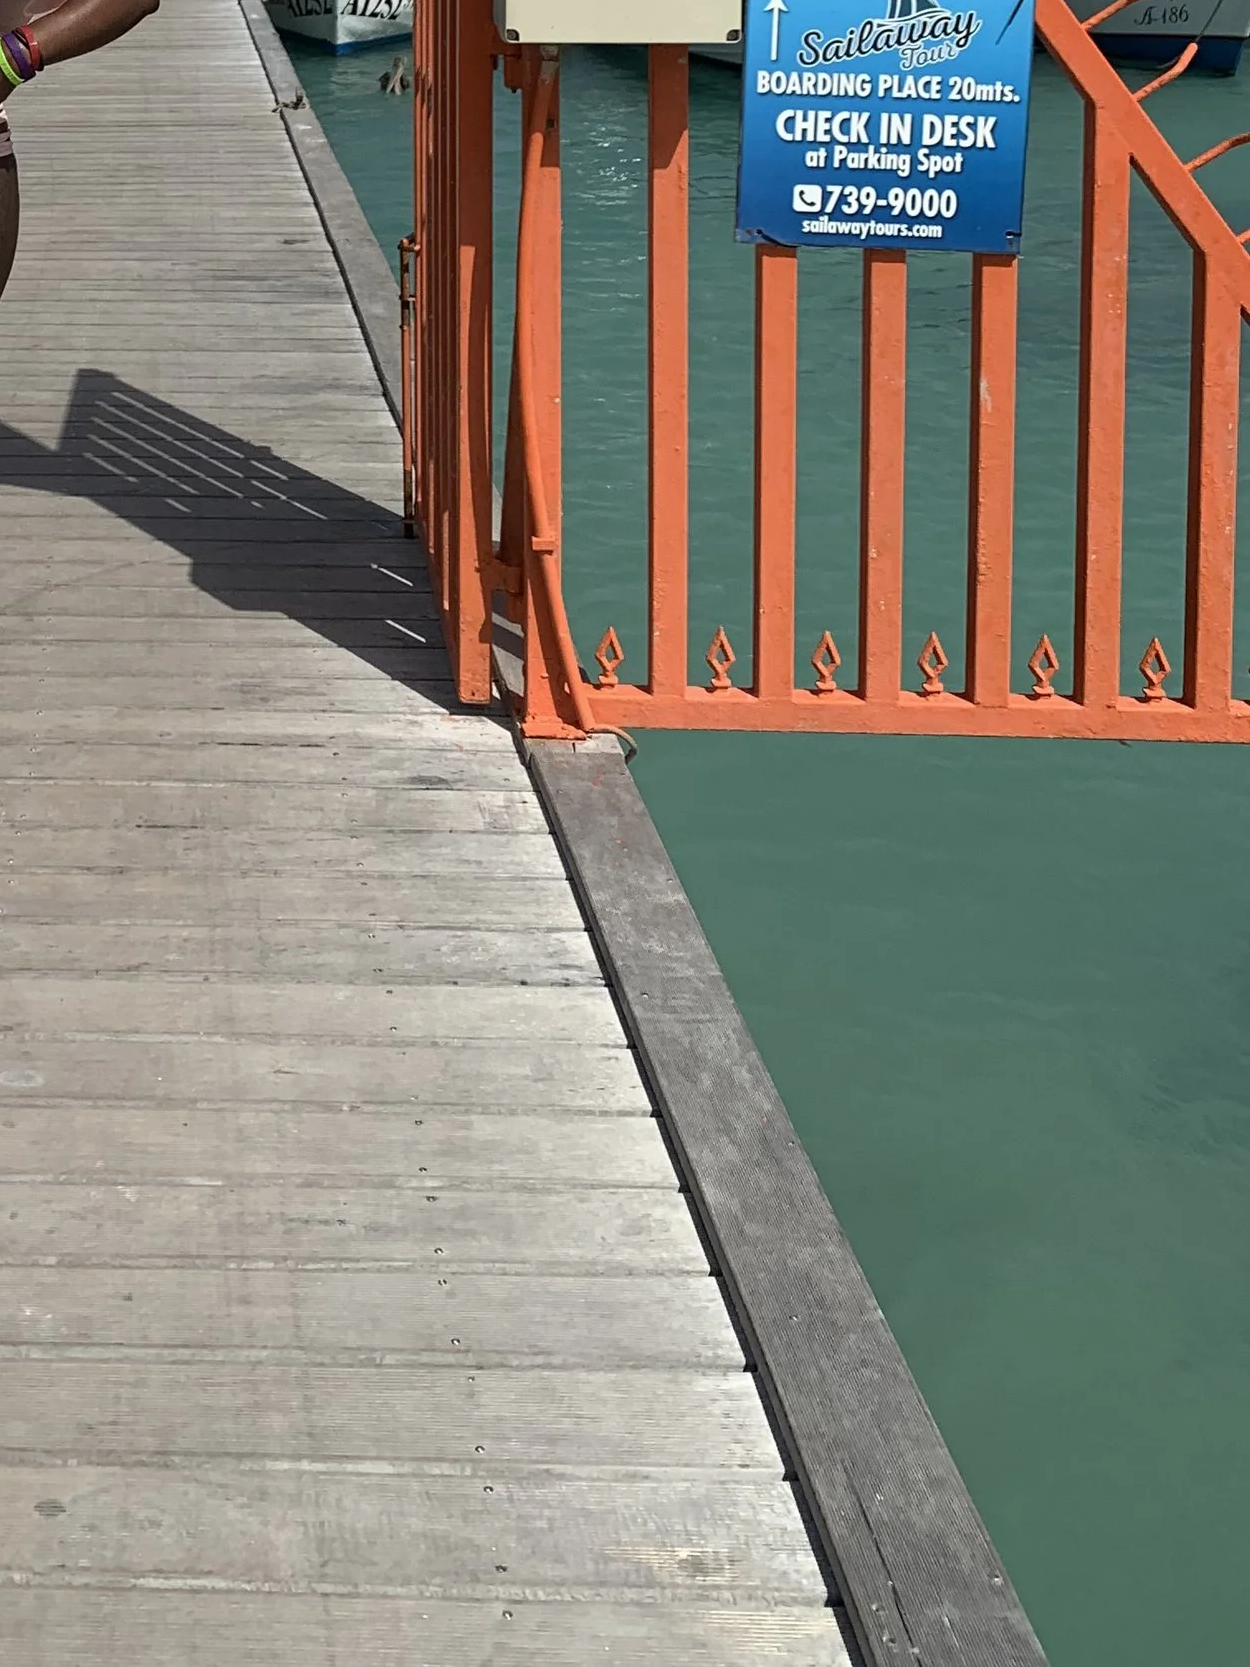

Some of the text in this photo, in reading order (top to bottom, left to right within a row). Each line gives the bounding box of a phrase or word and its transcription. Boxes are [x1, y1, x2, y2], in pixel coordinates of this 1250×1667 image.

[798, 11, 982, 68] Sailaway
[757, 70, 1020, 103] BOARDING PLACE 20mts.
[775, 109, 997, 148] CHECK IN DESK
[805, 145, 963, 178] at Parking Spot
[823, 186, 957, 218] 739-9000
[802, 216, 943, 240] sailawaytours.com
